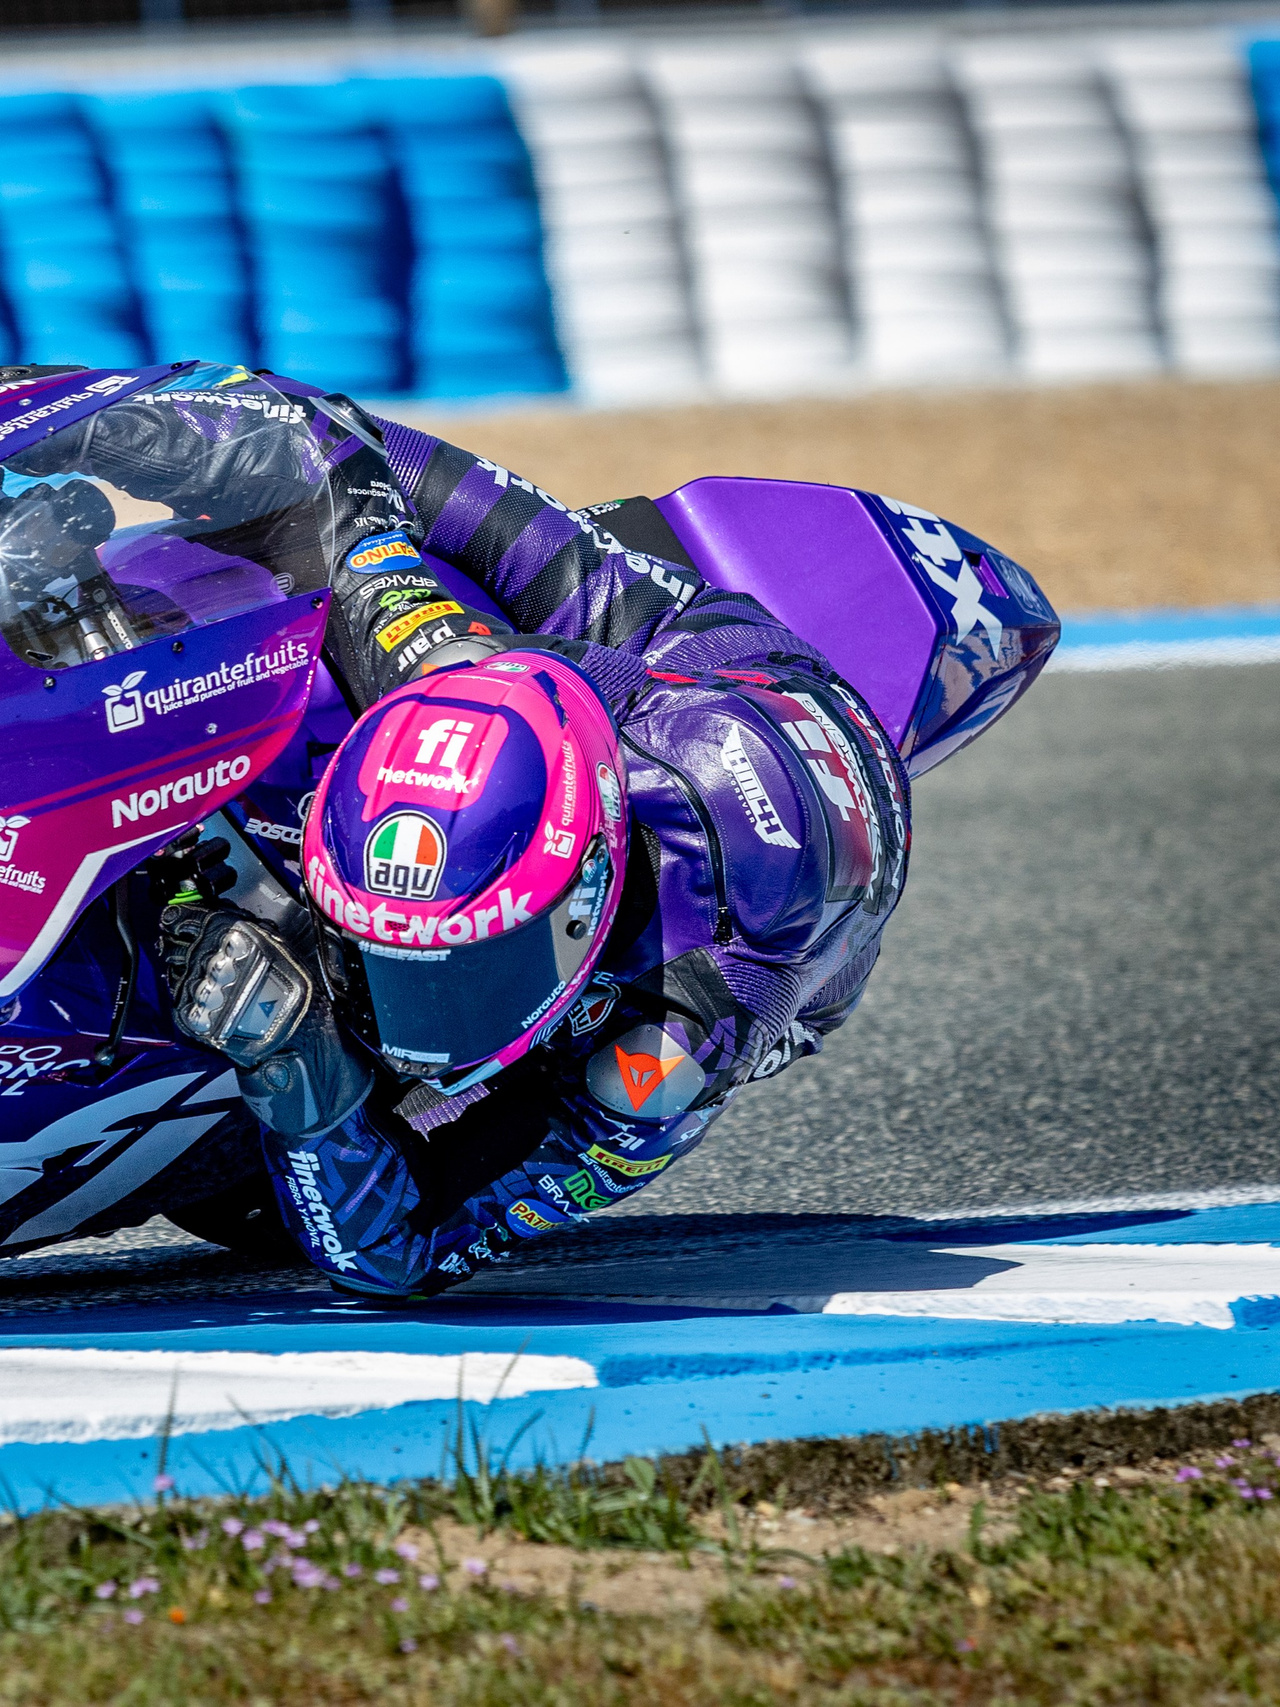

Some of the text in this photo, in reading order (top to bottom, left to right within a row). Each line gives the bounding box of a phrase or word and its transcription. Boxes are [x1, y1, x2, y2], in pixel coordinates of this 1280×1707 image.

[131, 393, 306, 424] finetwork
[352, 541, 420, 566] PATIÑO
[359, 574, 439, 600] BRAKES
[878, 494, 1003, 662] Xti
[386, 602, 456, 644] PIRELLI
[144, 640, 309, 715] quirantefruits
[162, 658, 309, 714] juice and purees of fruit and vegetable
[417, 719, 475, 768] fi
[111, 755, 251, 828] Norauto
[376, 766, 470, 793] network
[373, 860, 433, 897] agv
[307, 856, 534, 946] finetwork
[567, 887, 595, 922] fi
[587, 869, 609, 937] network
[358, 940, 451, 962] #BEFAST
[521, 980, 567, 1029] Norauto
[594, 1151, 665, 1174] PIRELLI
[284, 1175, 303, 1208] FIBRA
[299, 1207, 309, 1217] Y
[287, 1149, 359, 1272] finetwok
